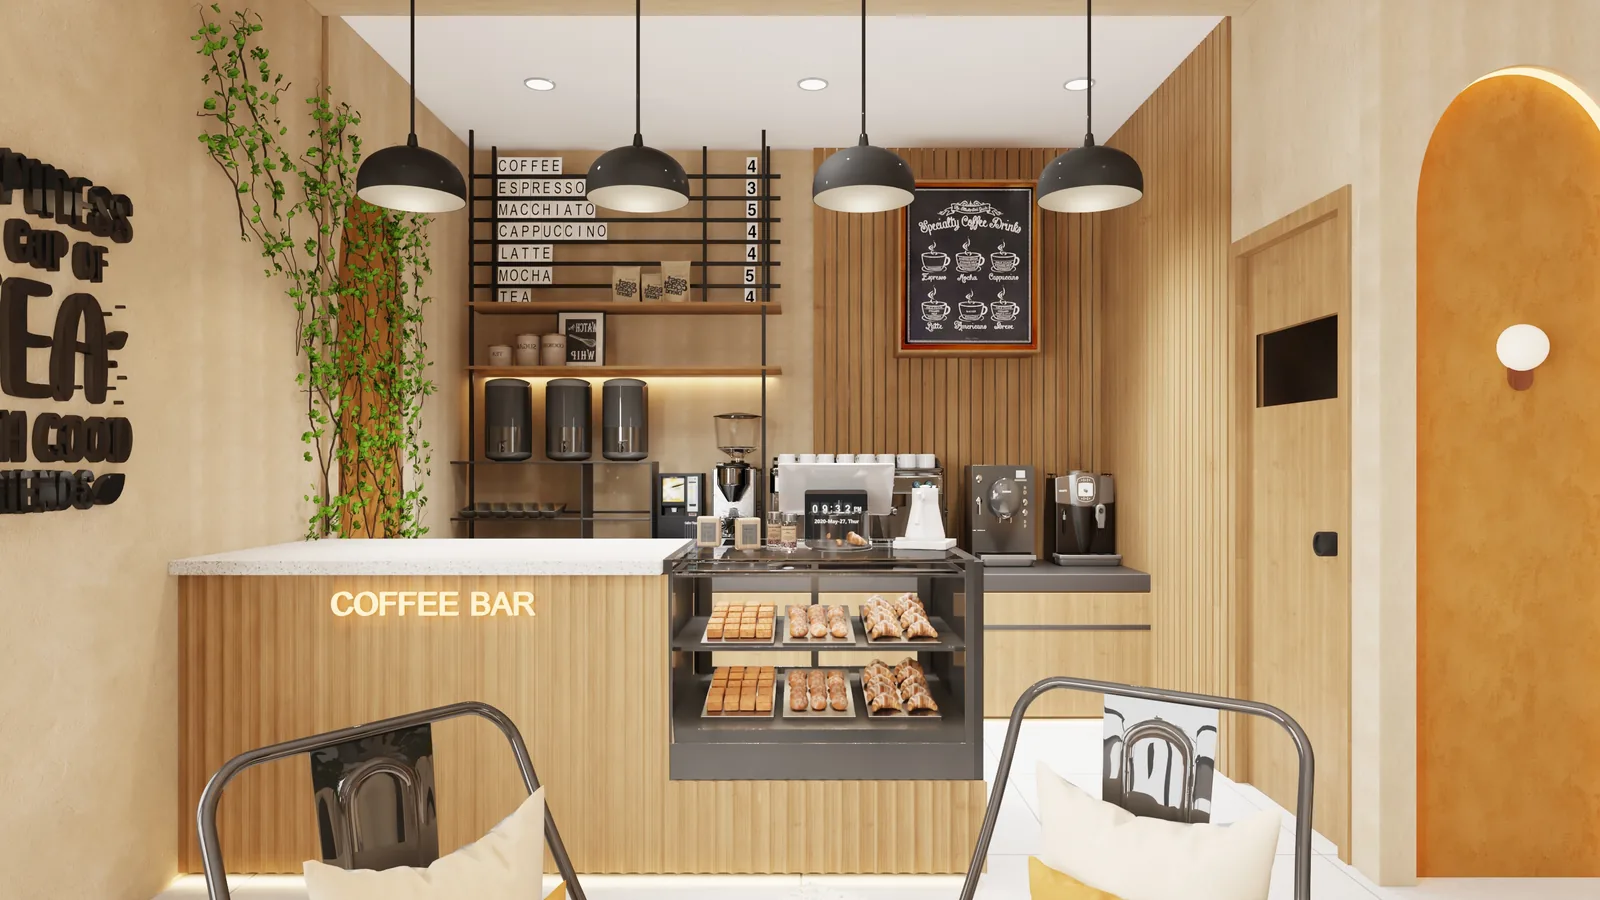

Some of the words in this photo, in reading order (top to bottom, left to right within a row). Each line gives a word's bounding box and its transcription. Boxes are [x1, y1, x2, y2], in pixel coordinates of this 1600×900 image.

[498, 159, 560, 172] COFFEE
[747, 159, 757, 173] 4
[499, 181, 585, 194] ESPRESSO
[747, 181, 756, 195] 3
[498, 203, 595, 216] MACCHIATO
[747, 203, 757, 216] 5
[499, 224, 606, 238] CAPPUCCINO
[747, 224, 757, 238] 4
[918, 216, 960, 236] Specialty
[961, 215, 988, 231] Coffee
[989, 216, 1022, 234] Drinks
[3, 218, 69, 272] CUP
[501, 247, 551, 260] LATTE
[747, 246, 757, 260] 4
[499, 269, 551, 282] MOCHA
[745, 269, 754, 282] 5
[957, 273, 978, 284] Mocha
[500, 290, 530, 302] TEA
[746, 290, 755, 302] 4
[925, 321, 943, 332] Latte
[0, 276, 108, 404] EA
[330, 590, 460, 617] COFFEE
[470, 591, 536, 617] BAR
